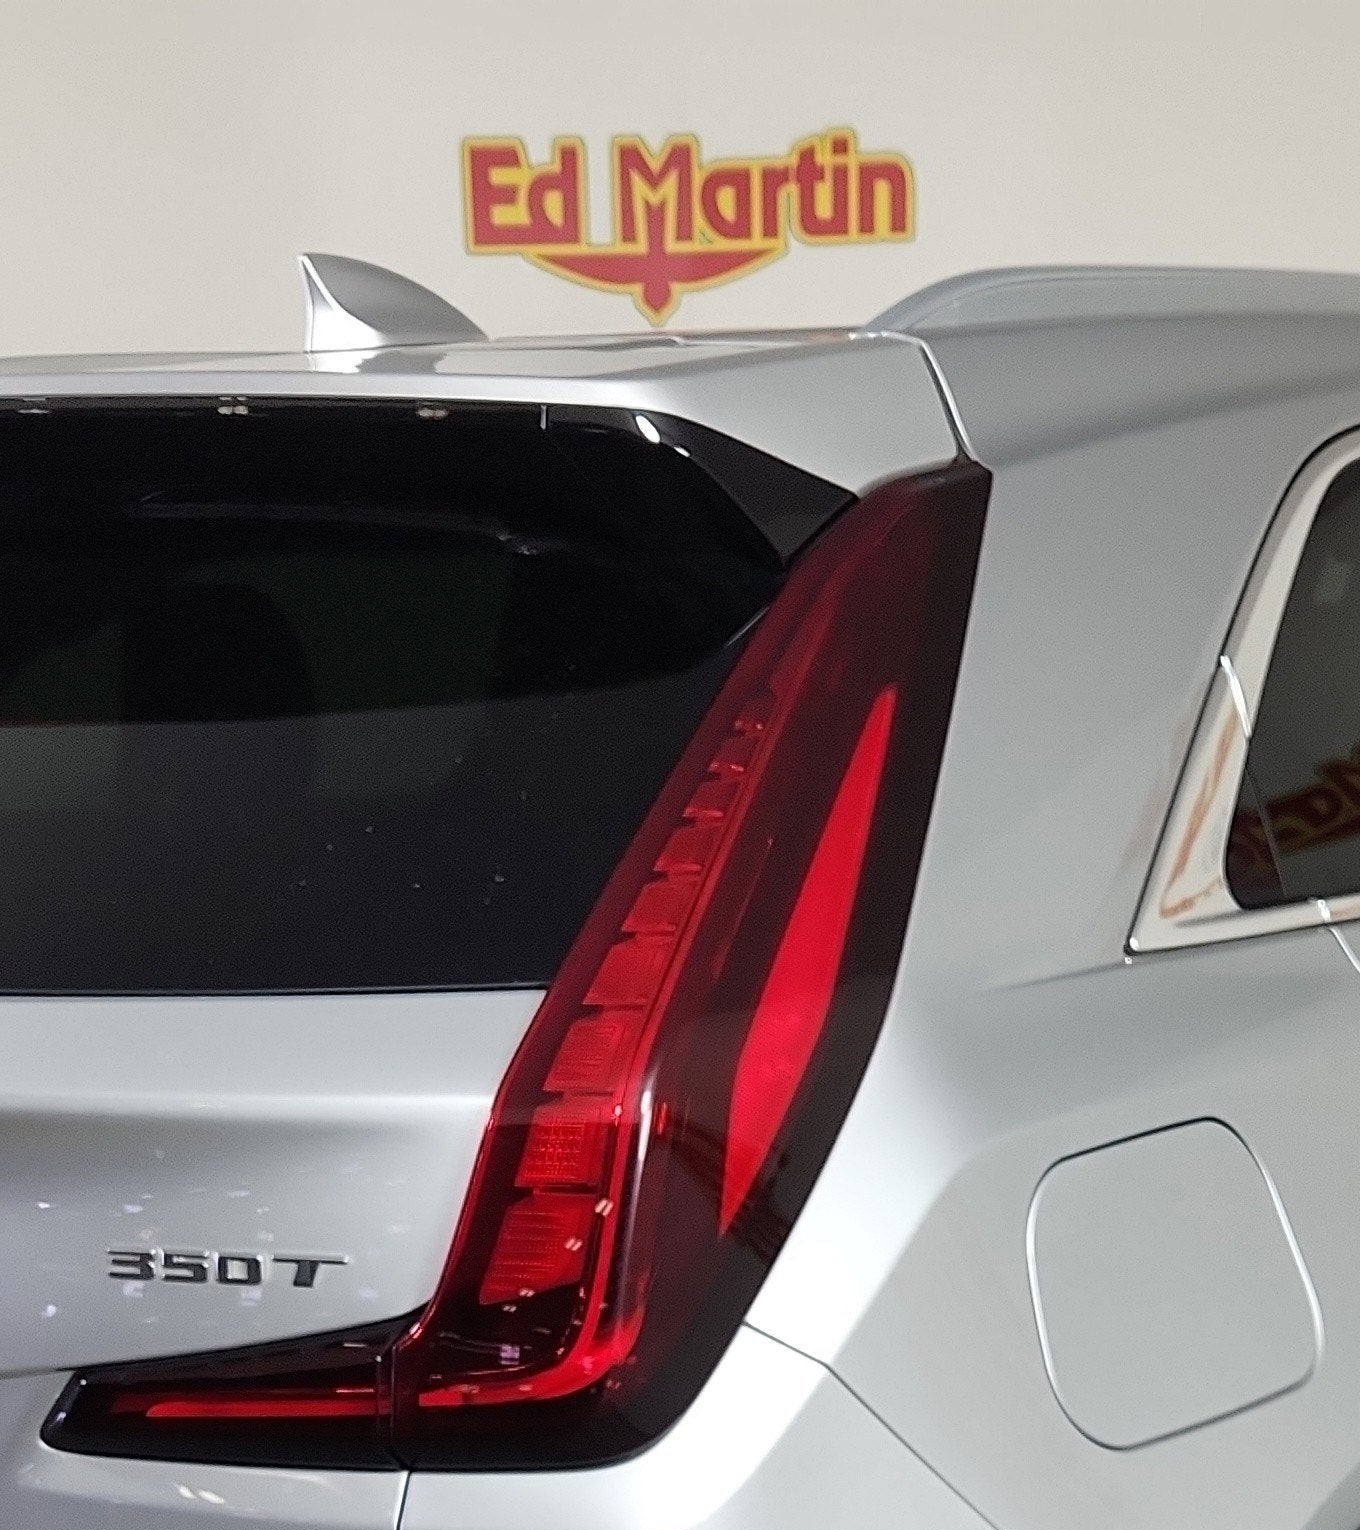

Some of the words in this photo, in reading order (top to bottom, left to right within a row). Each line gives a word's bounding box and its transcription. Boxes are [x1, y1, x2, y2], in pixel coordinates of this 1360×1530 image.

[465, 139, 581, 251] Ed
[615, 130, 911, 244] Martin
[106, 1248, 350, 1288] 350T
